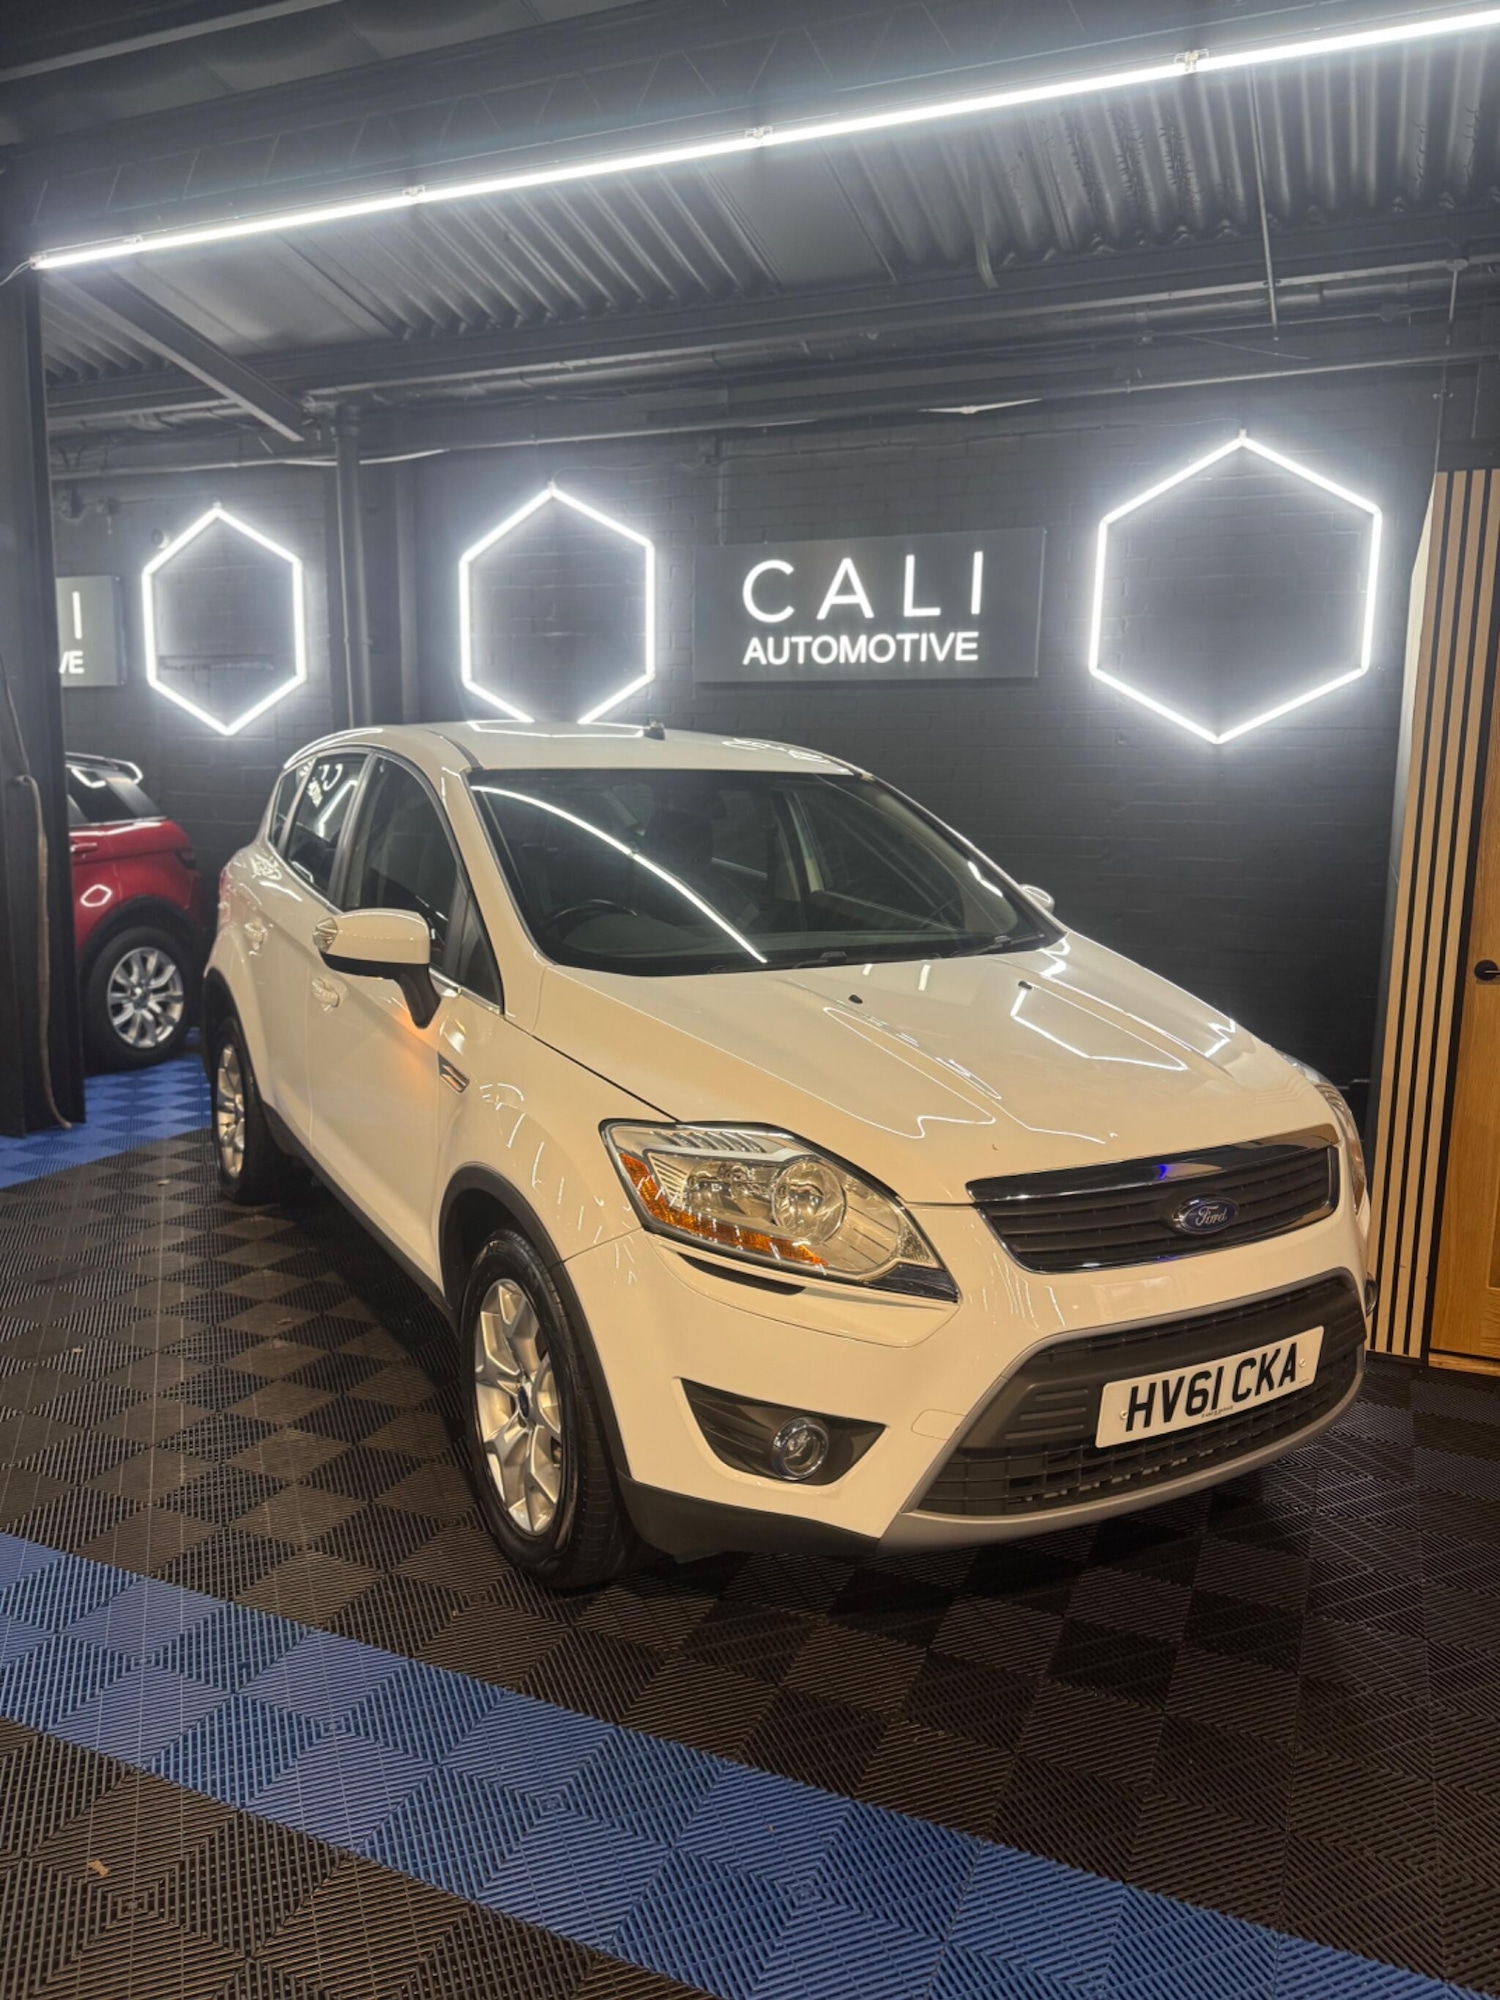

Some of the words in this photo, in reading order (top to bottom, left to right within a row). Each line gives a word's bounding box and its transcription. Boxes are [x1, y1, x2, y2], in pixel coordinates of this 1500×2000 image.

[742, 550, 984, 624] CALI
[742, 631, 980, 666] AUTOMOTIVE
[1195, 1205, 1228, 1227] Ford
[1125, 1365, 1225, 1433] HV61
[1231, 1342, 1298, 1403] CKA
